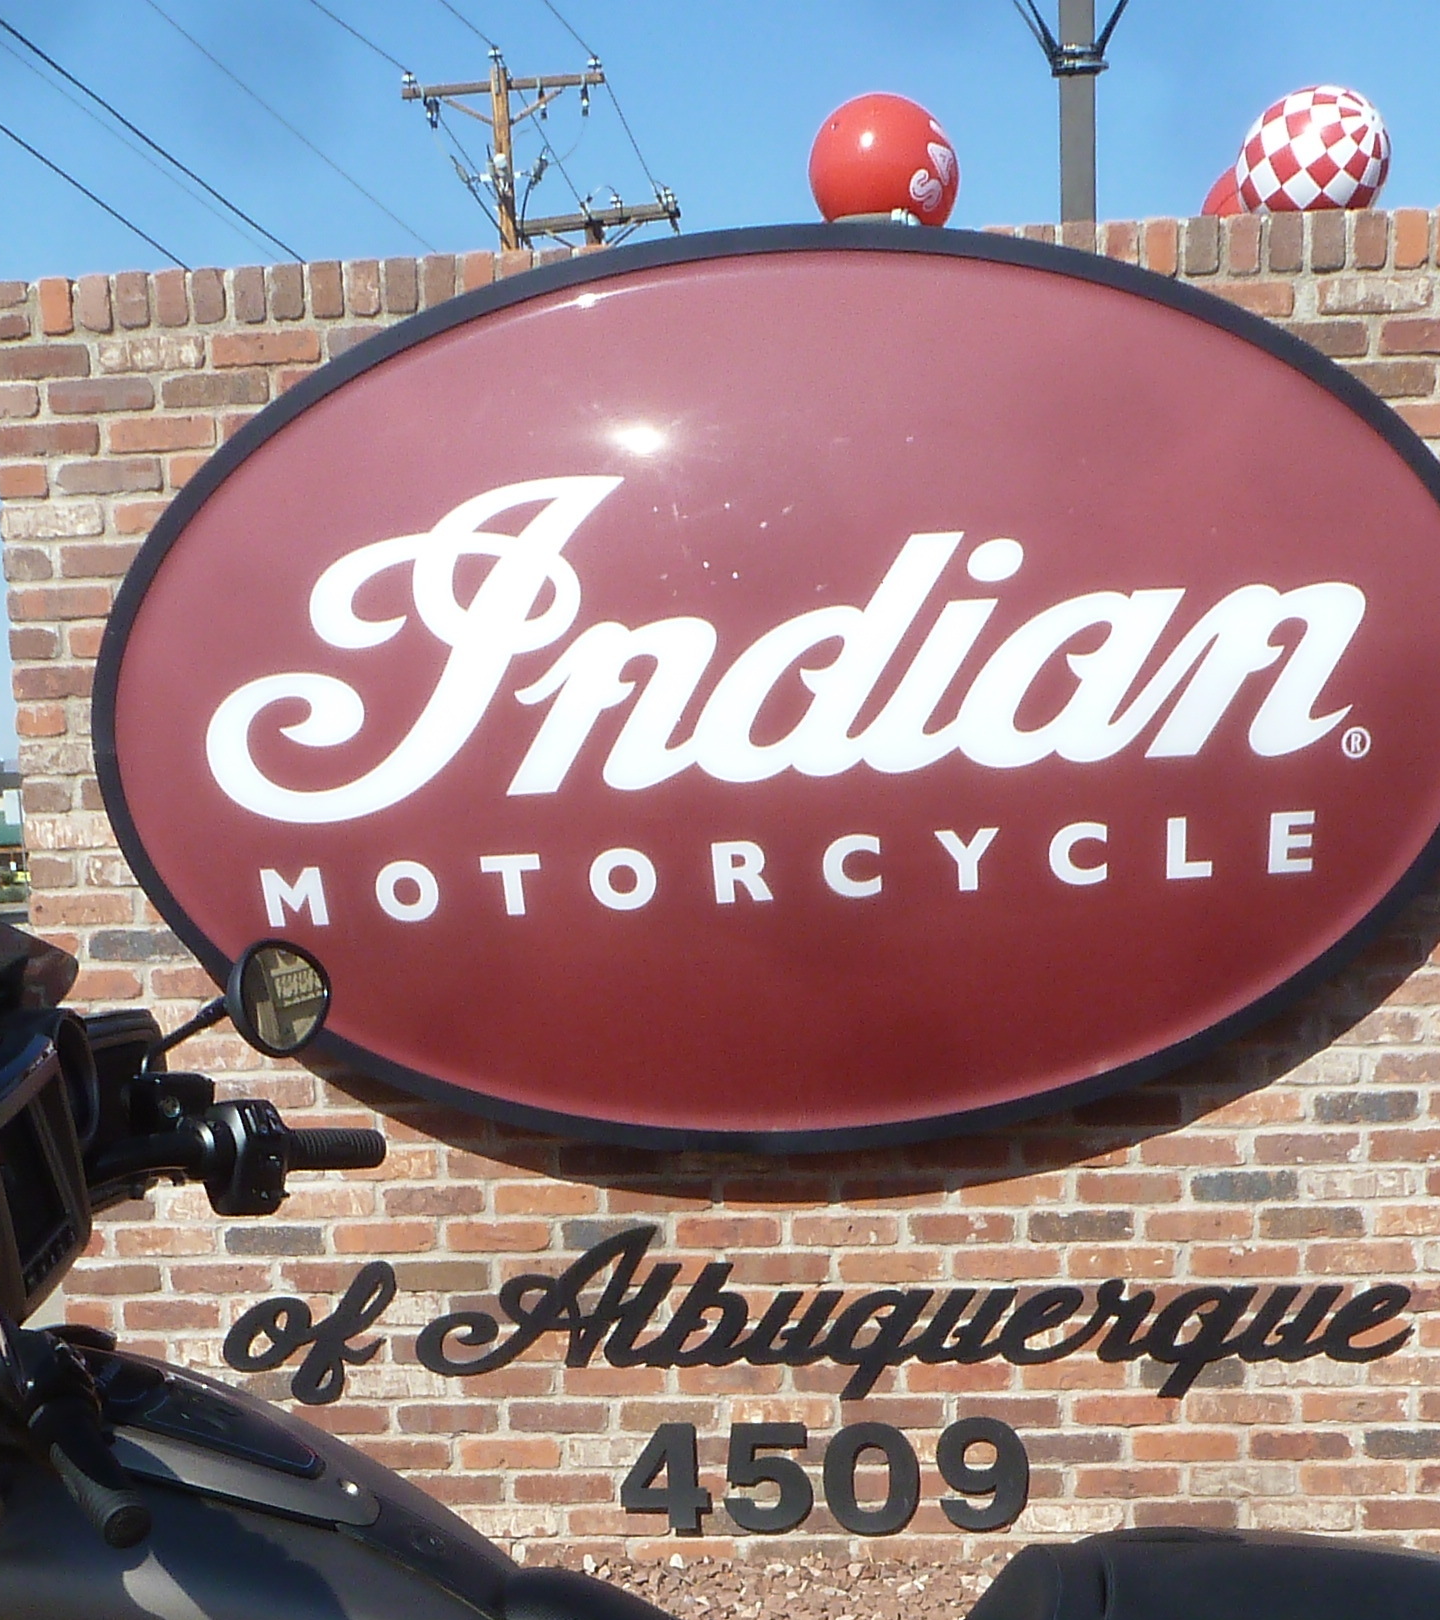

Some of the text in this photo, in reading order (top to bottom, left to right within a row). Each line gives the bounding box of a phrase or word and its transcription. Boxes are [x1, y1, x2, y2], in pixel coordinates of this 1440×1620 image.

[206, 470, 1367, 824] Indian
[259, 810, 1316, 927] MOTORCYCLE
[223, 1224, 1413, 1405] of Albuquerque
[620, 1416, 1030, 1537] 4509
